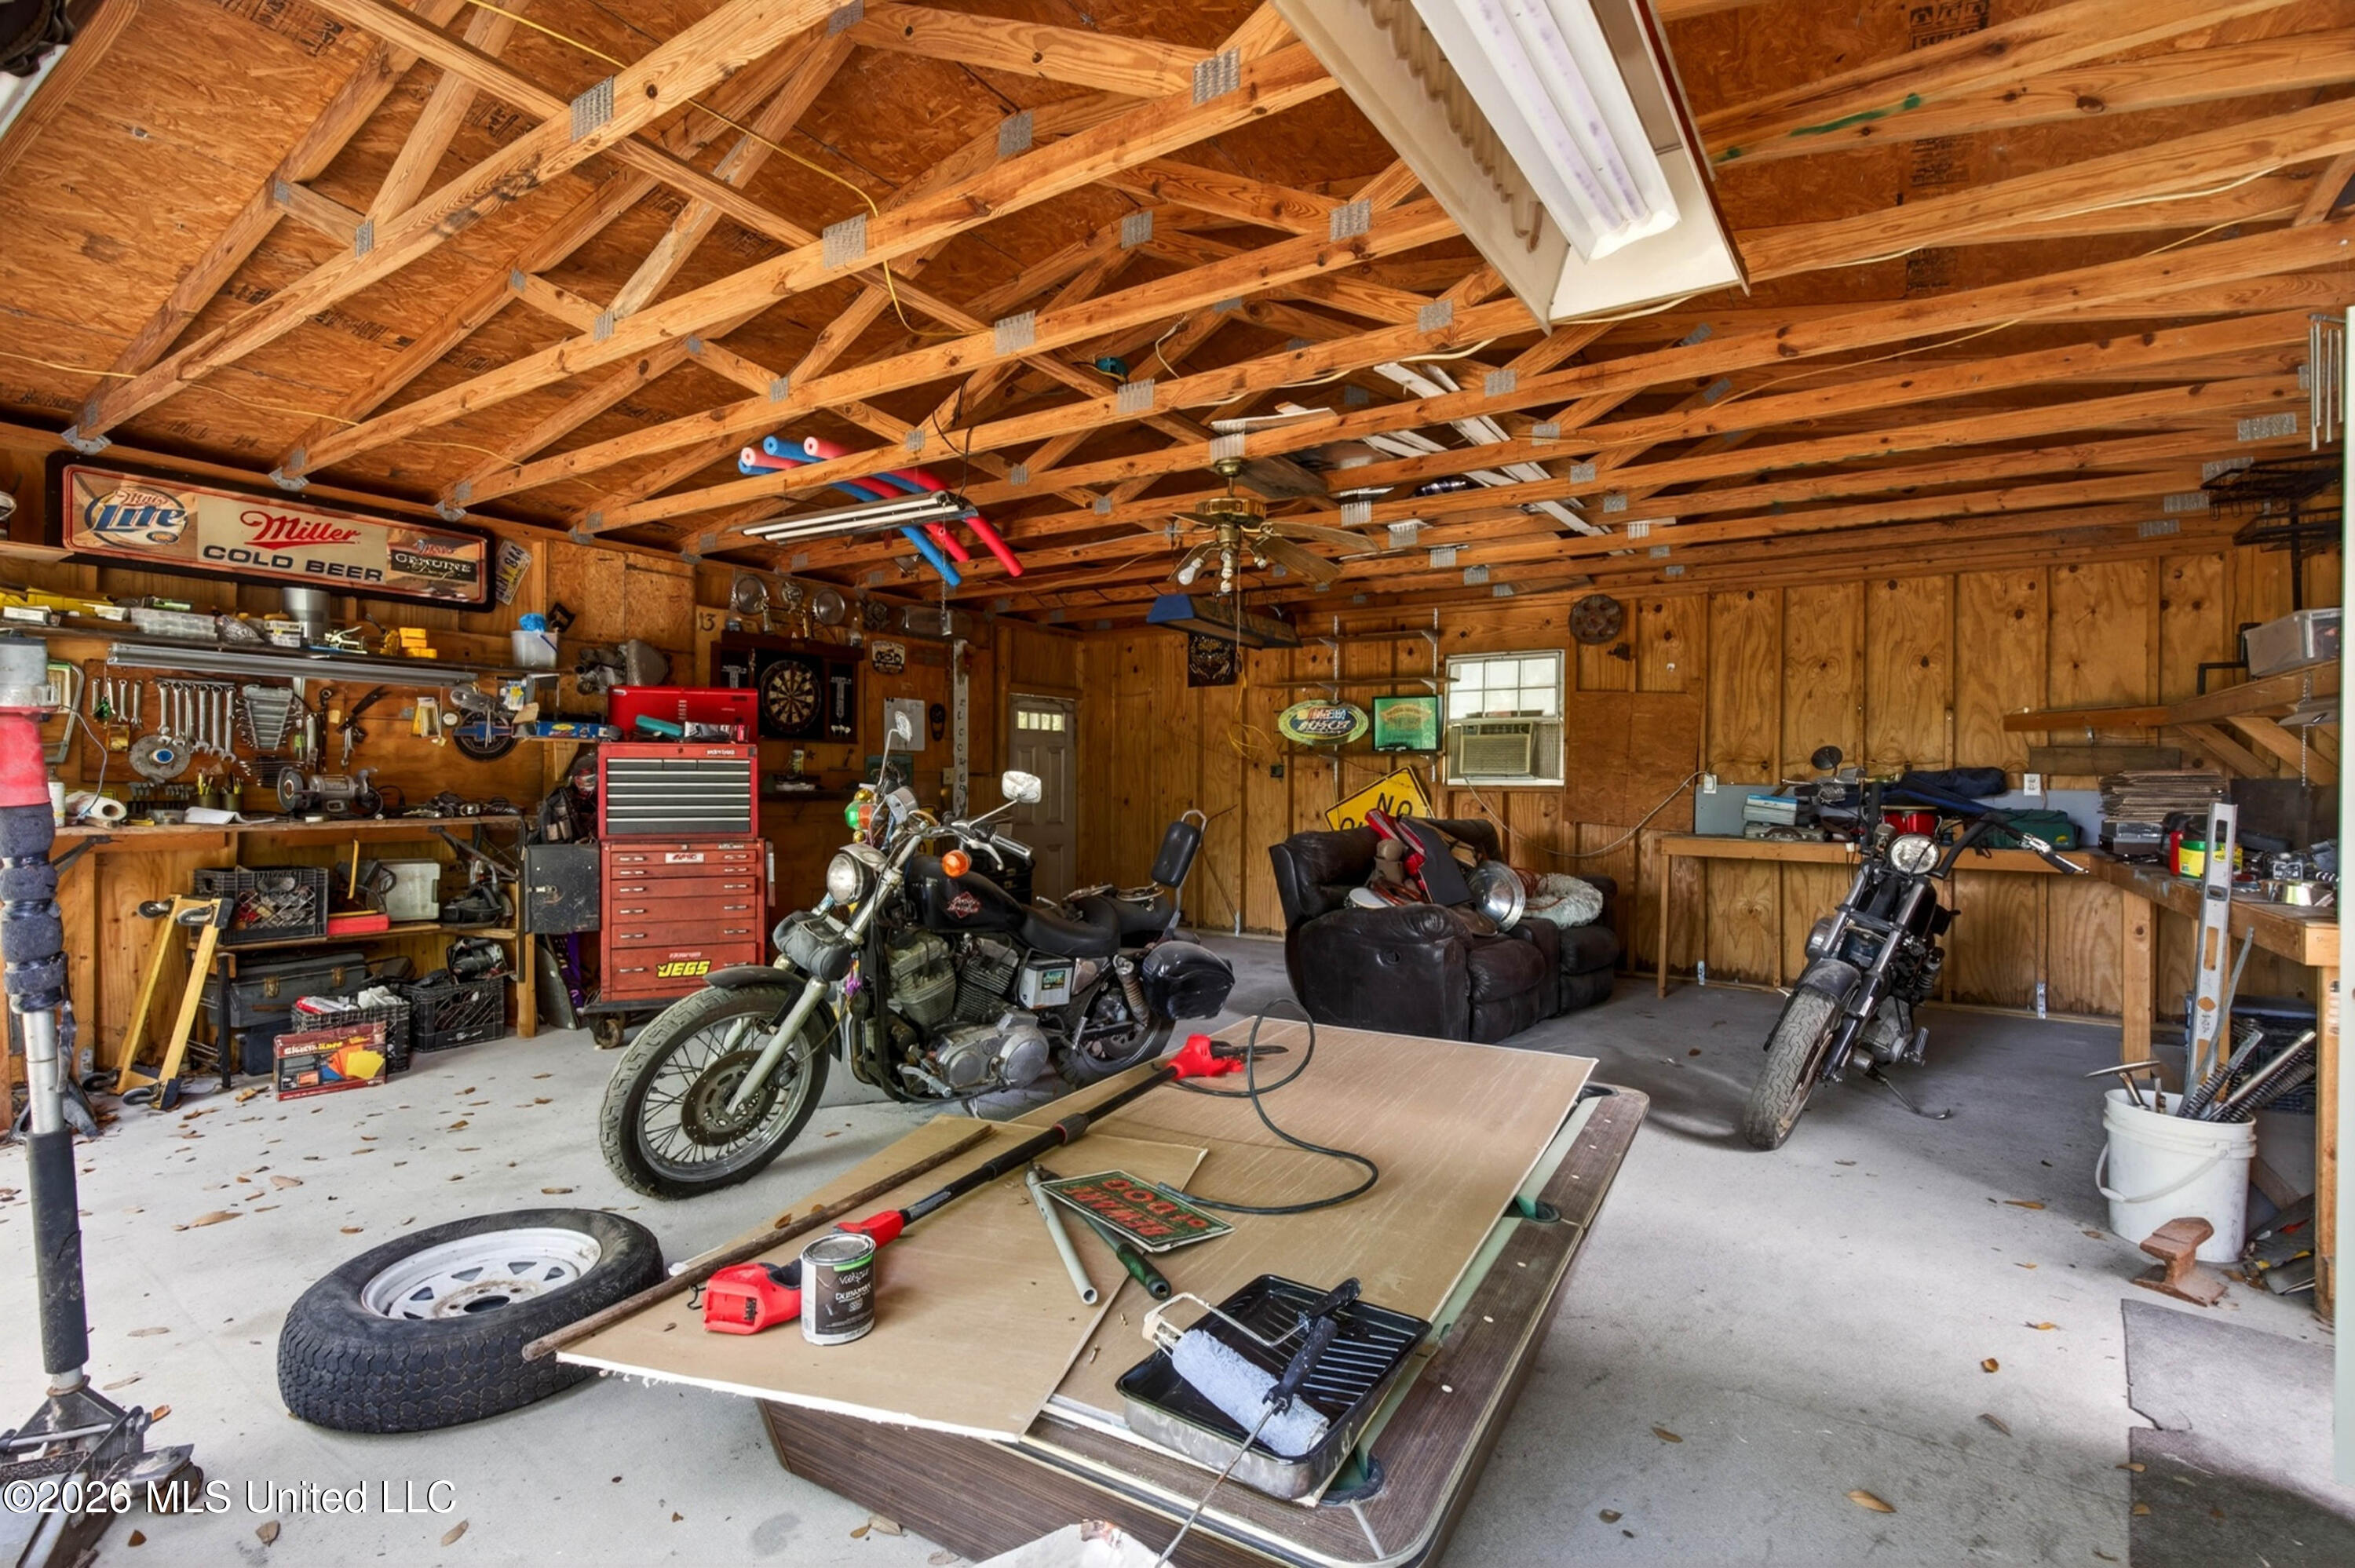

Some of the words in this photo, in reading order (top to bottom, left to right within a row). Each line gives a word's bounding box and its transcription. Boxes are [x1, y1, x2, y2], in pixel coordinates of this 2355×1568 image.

[92, 505, 186, 532] Lite
[240, 510, 362, 542] Miller
[203, 545, 294, 569] COLD
[305, 559, 383, 582] BEER
[1377, 792, 1412, 817] NO
[657, 961, 710, 978] JEGS
[1102, 1179, 1178, 1215] DOG
